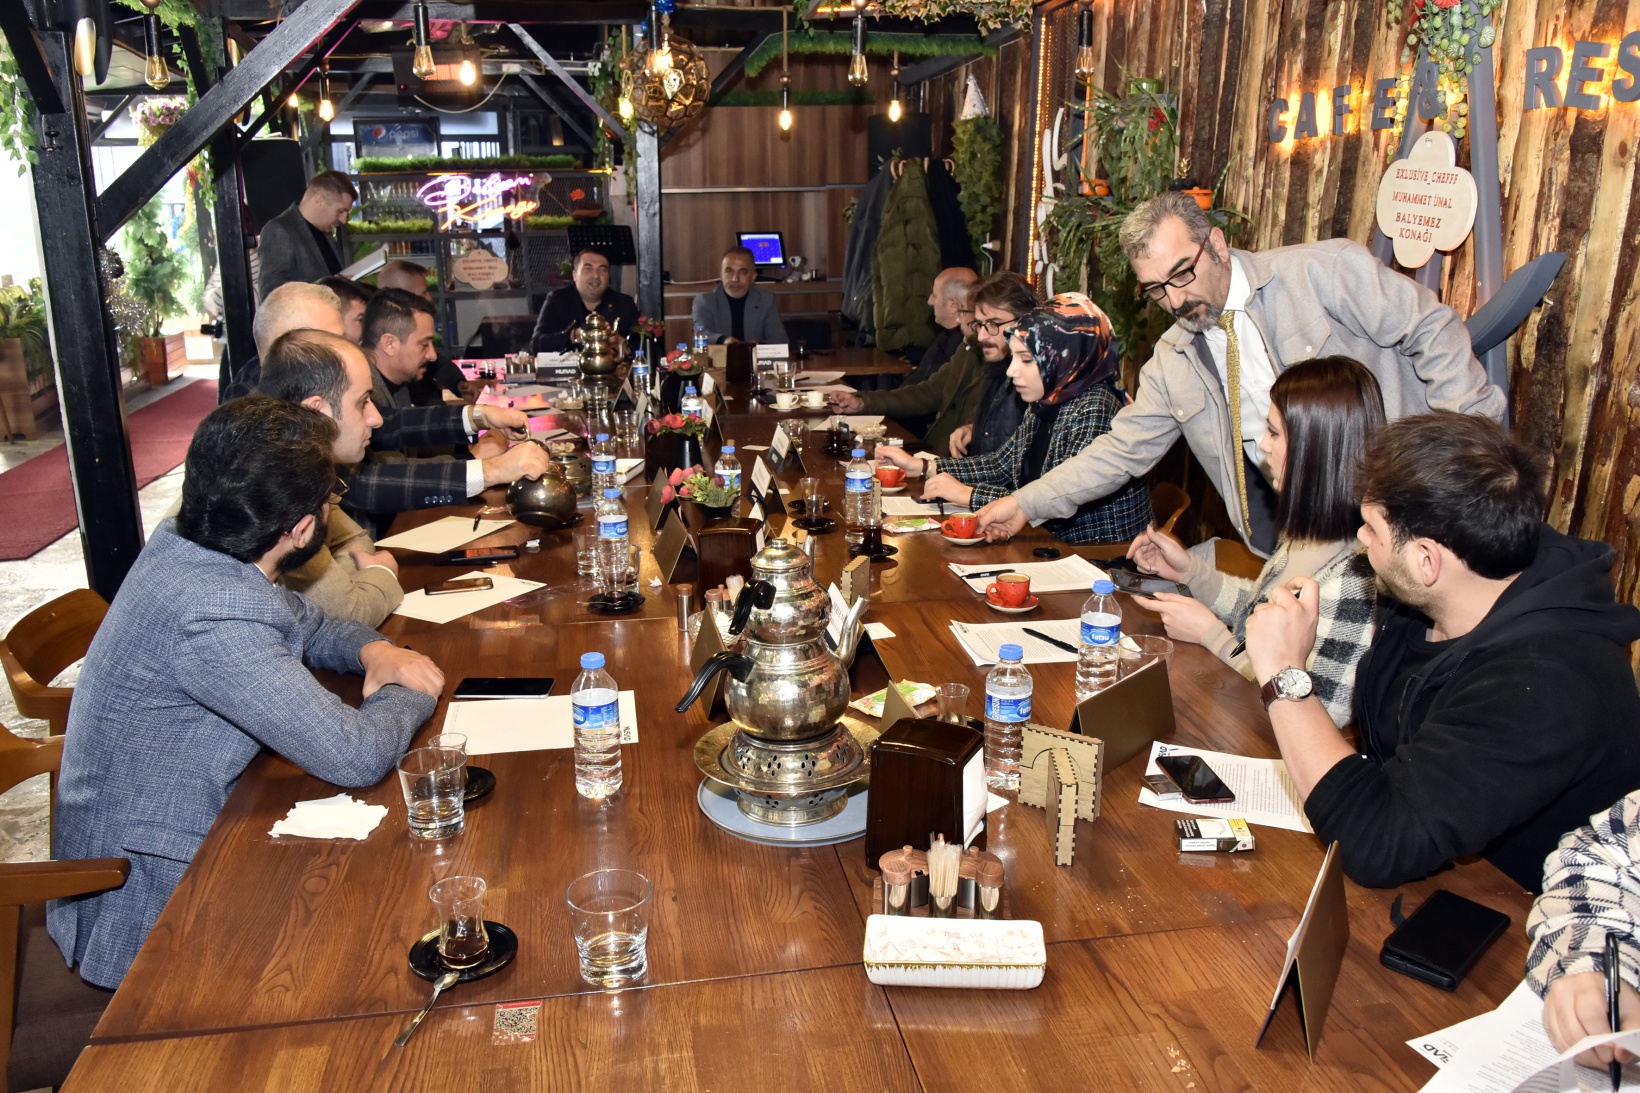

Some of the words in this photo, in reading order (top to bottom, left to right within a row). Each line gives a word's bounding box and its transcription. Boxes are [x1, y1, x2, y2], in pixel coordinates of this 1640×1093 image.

[1269, 77, 1397, 143] CAFE
[1523, 30, 1640, 111] RES
[389, 129, 418, 140] pepsi
[1392, 191, 1432, 206] MUHAMMET
[1433, 194, 1452, 208] ÜNAL
[1395, 212, 1442, 229] BALYEMEZ
[1398, 227, 1433, 243] KONAĞI
[1091, 633, 1110, 641] fatsu
